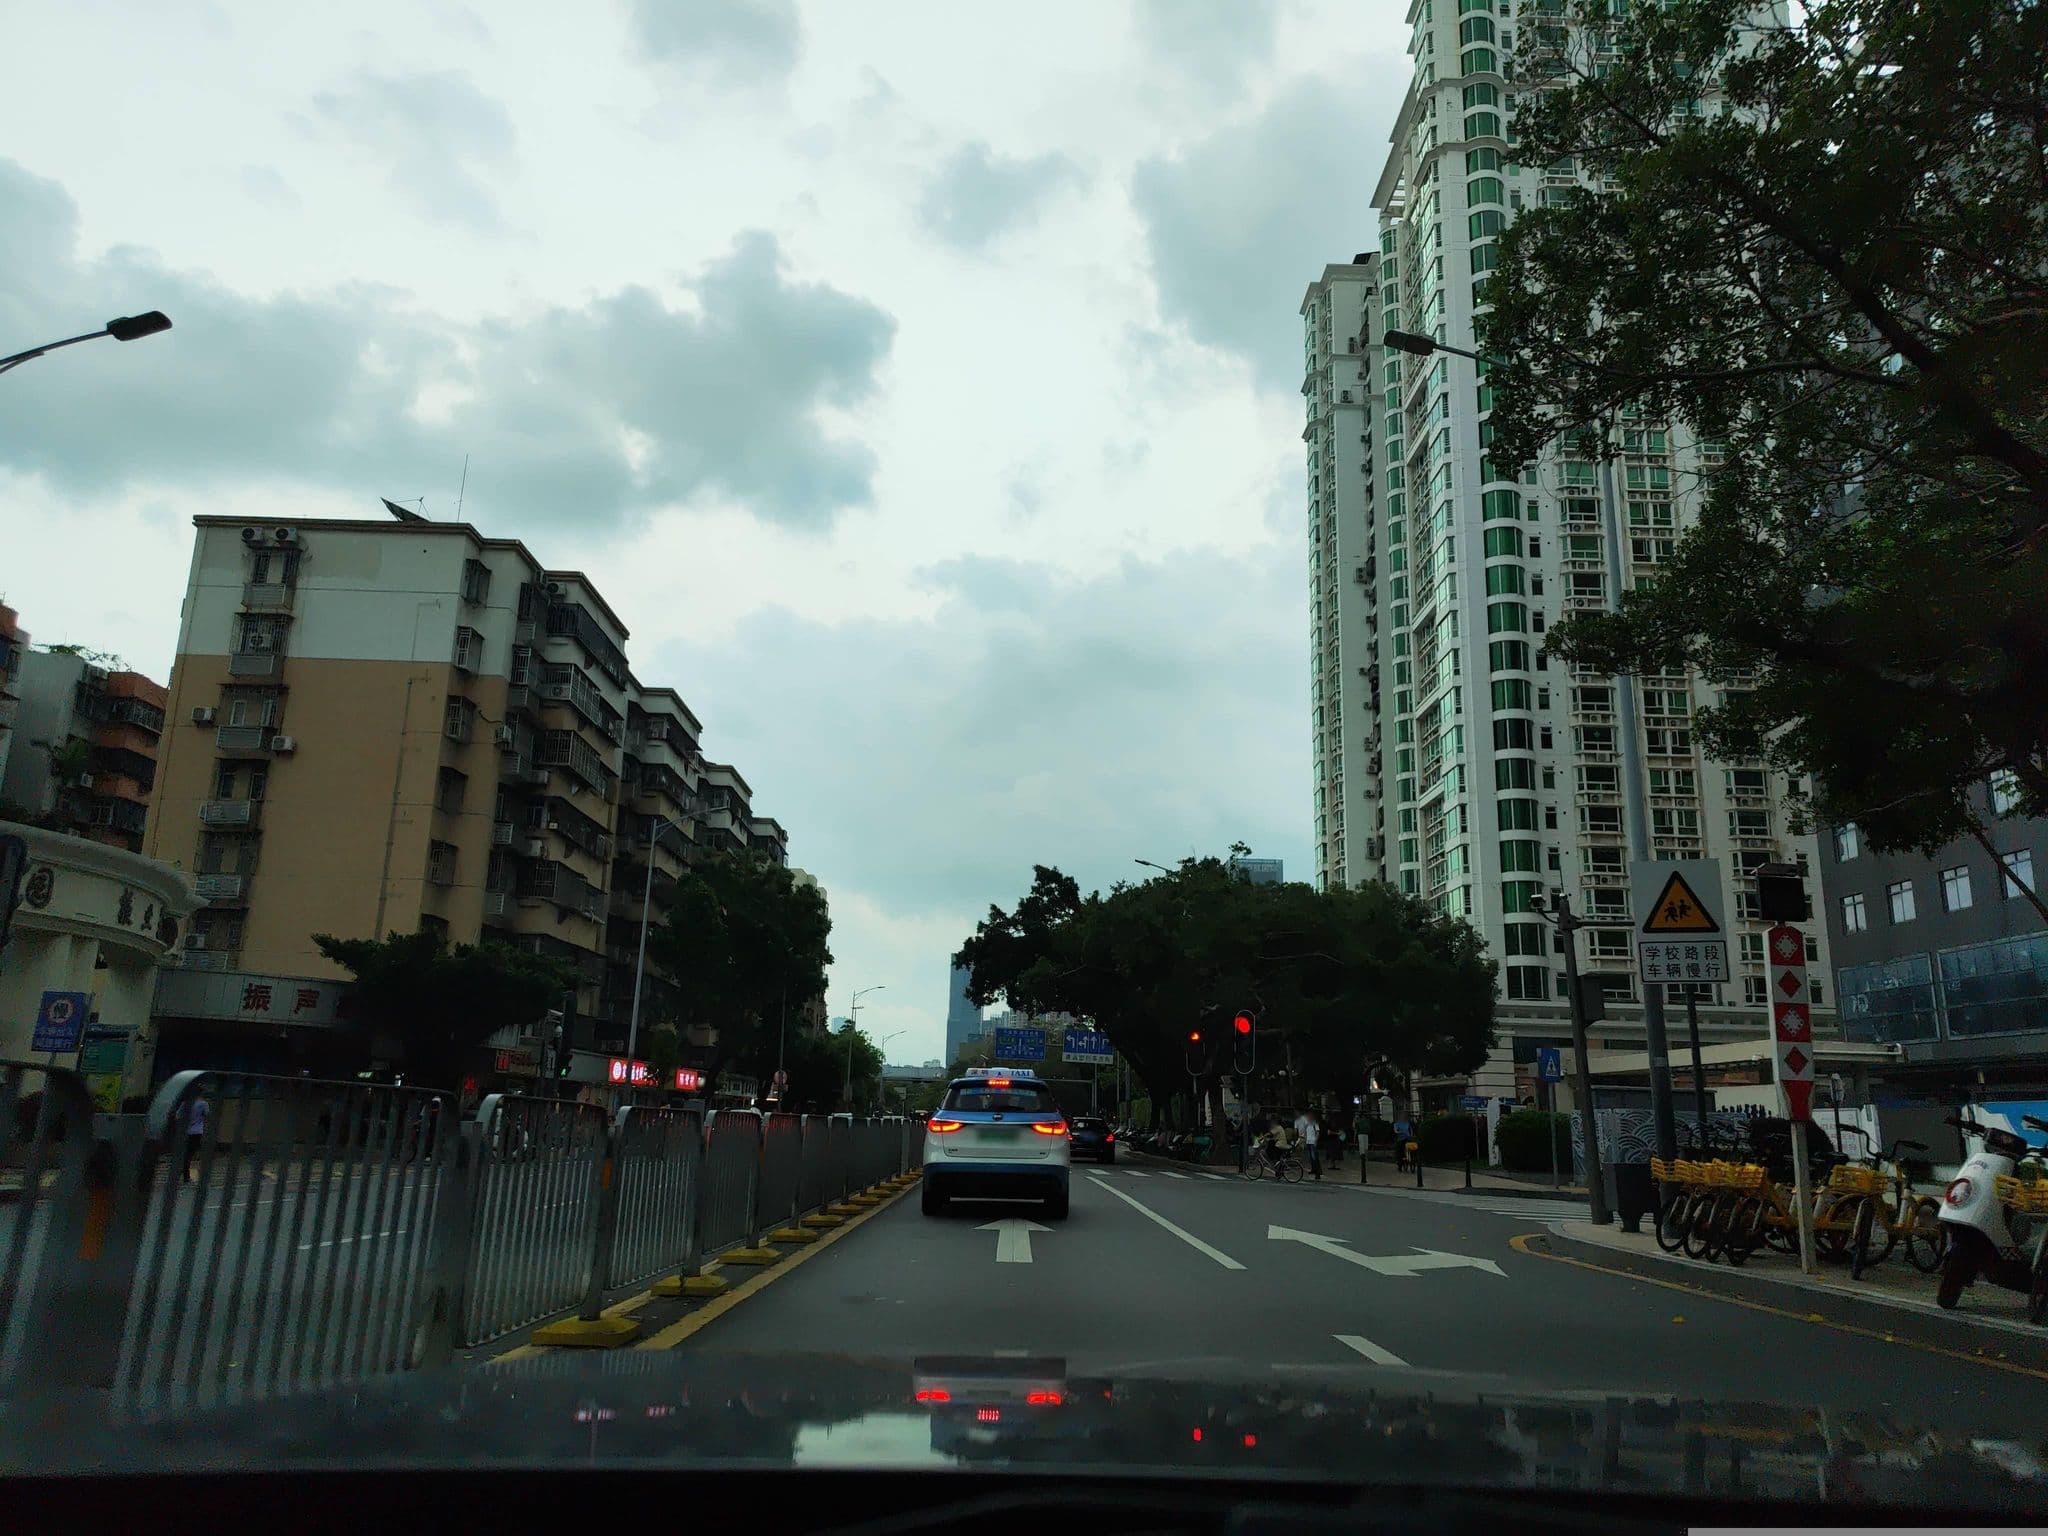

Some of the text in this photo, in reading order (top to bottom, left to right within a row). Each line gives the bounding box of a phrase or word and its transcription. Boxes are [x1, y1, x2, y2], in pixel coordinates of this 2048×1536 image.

[1645, 945, 1720, 961] 学校路段
[1647, 962, 1721, 978] 车辆慢行
[243, 983, 347, 1015] 振声
